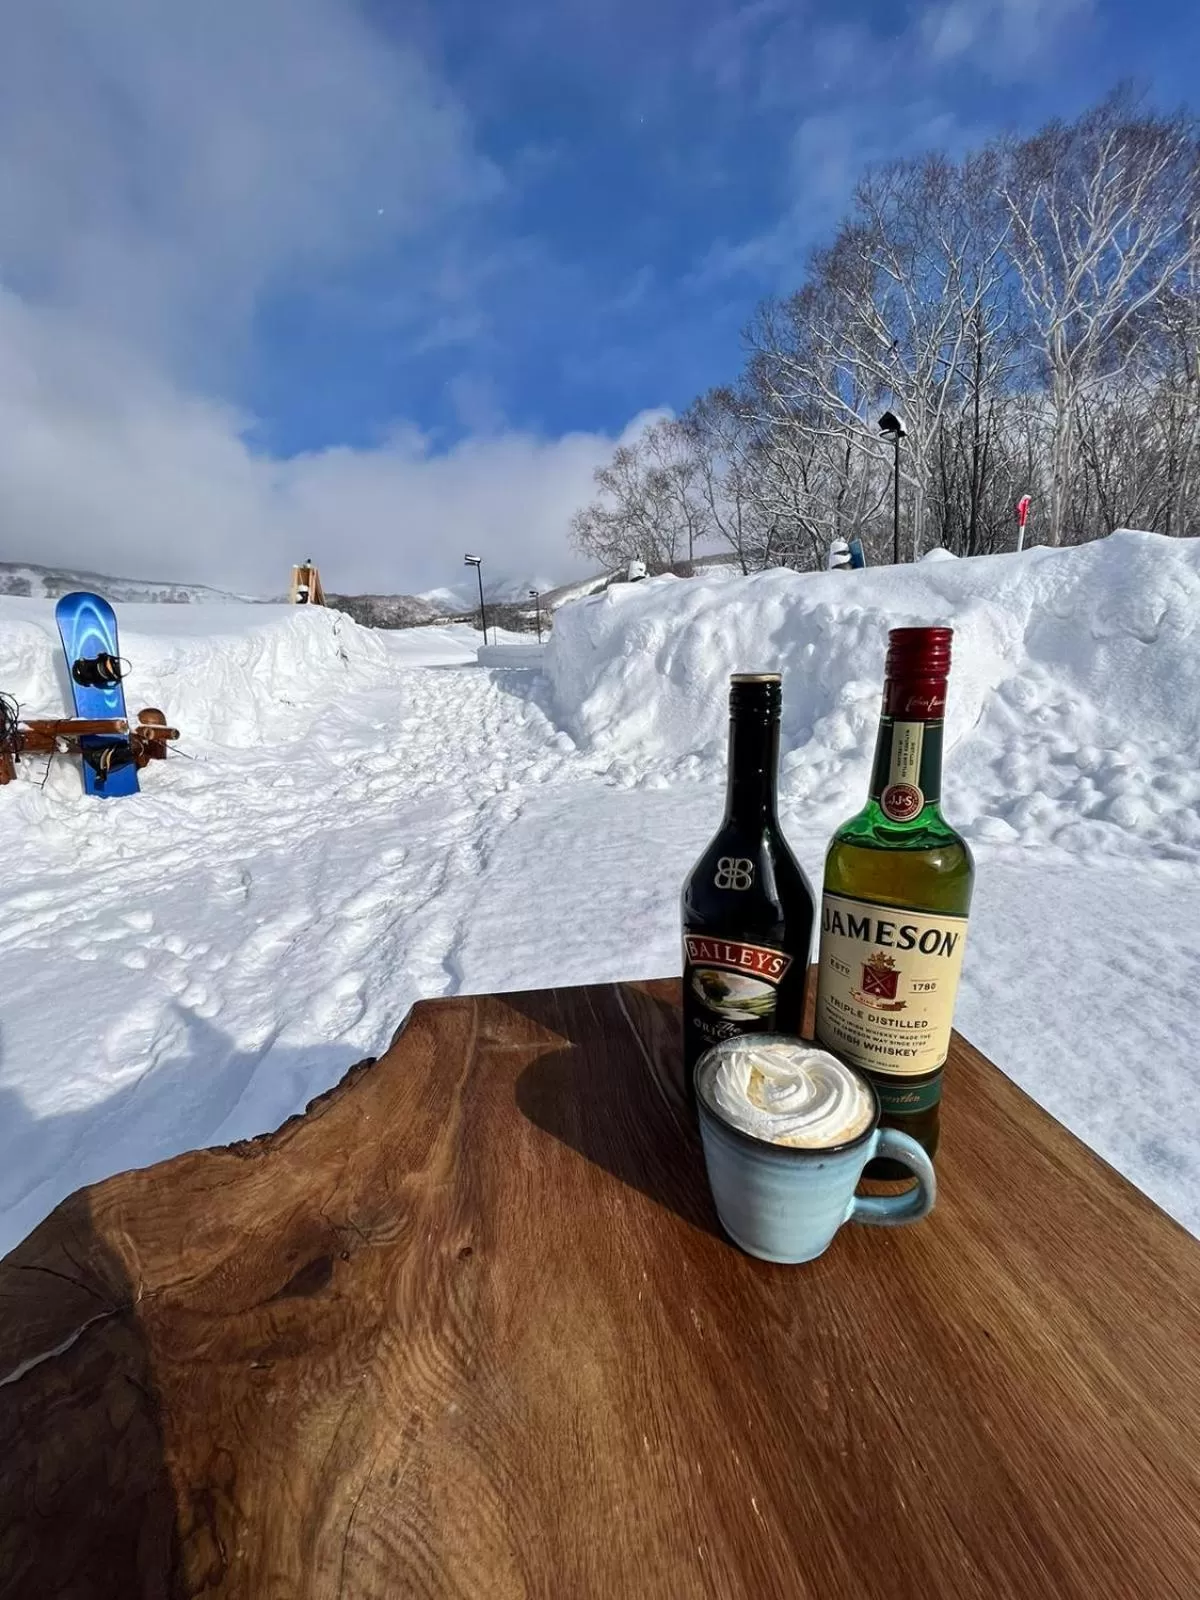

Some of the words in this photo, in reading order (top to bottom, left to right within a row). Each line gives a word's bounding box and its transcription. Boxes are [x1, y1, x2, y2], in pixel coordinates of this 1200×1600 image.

[823, 907, 959, 958] JAMESON
[688, 940, 784, 974] BAILEYS
[913, 983, 936, 991] 1780
[829, 996, 864, 1019] TRIPLE
[867, 1014, 928, 1028] DISTILLED
[833, 1026, 860, 1046] IRISH
[863, 1041, 918, 1057] WHISKEY
